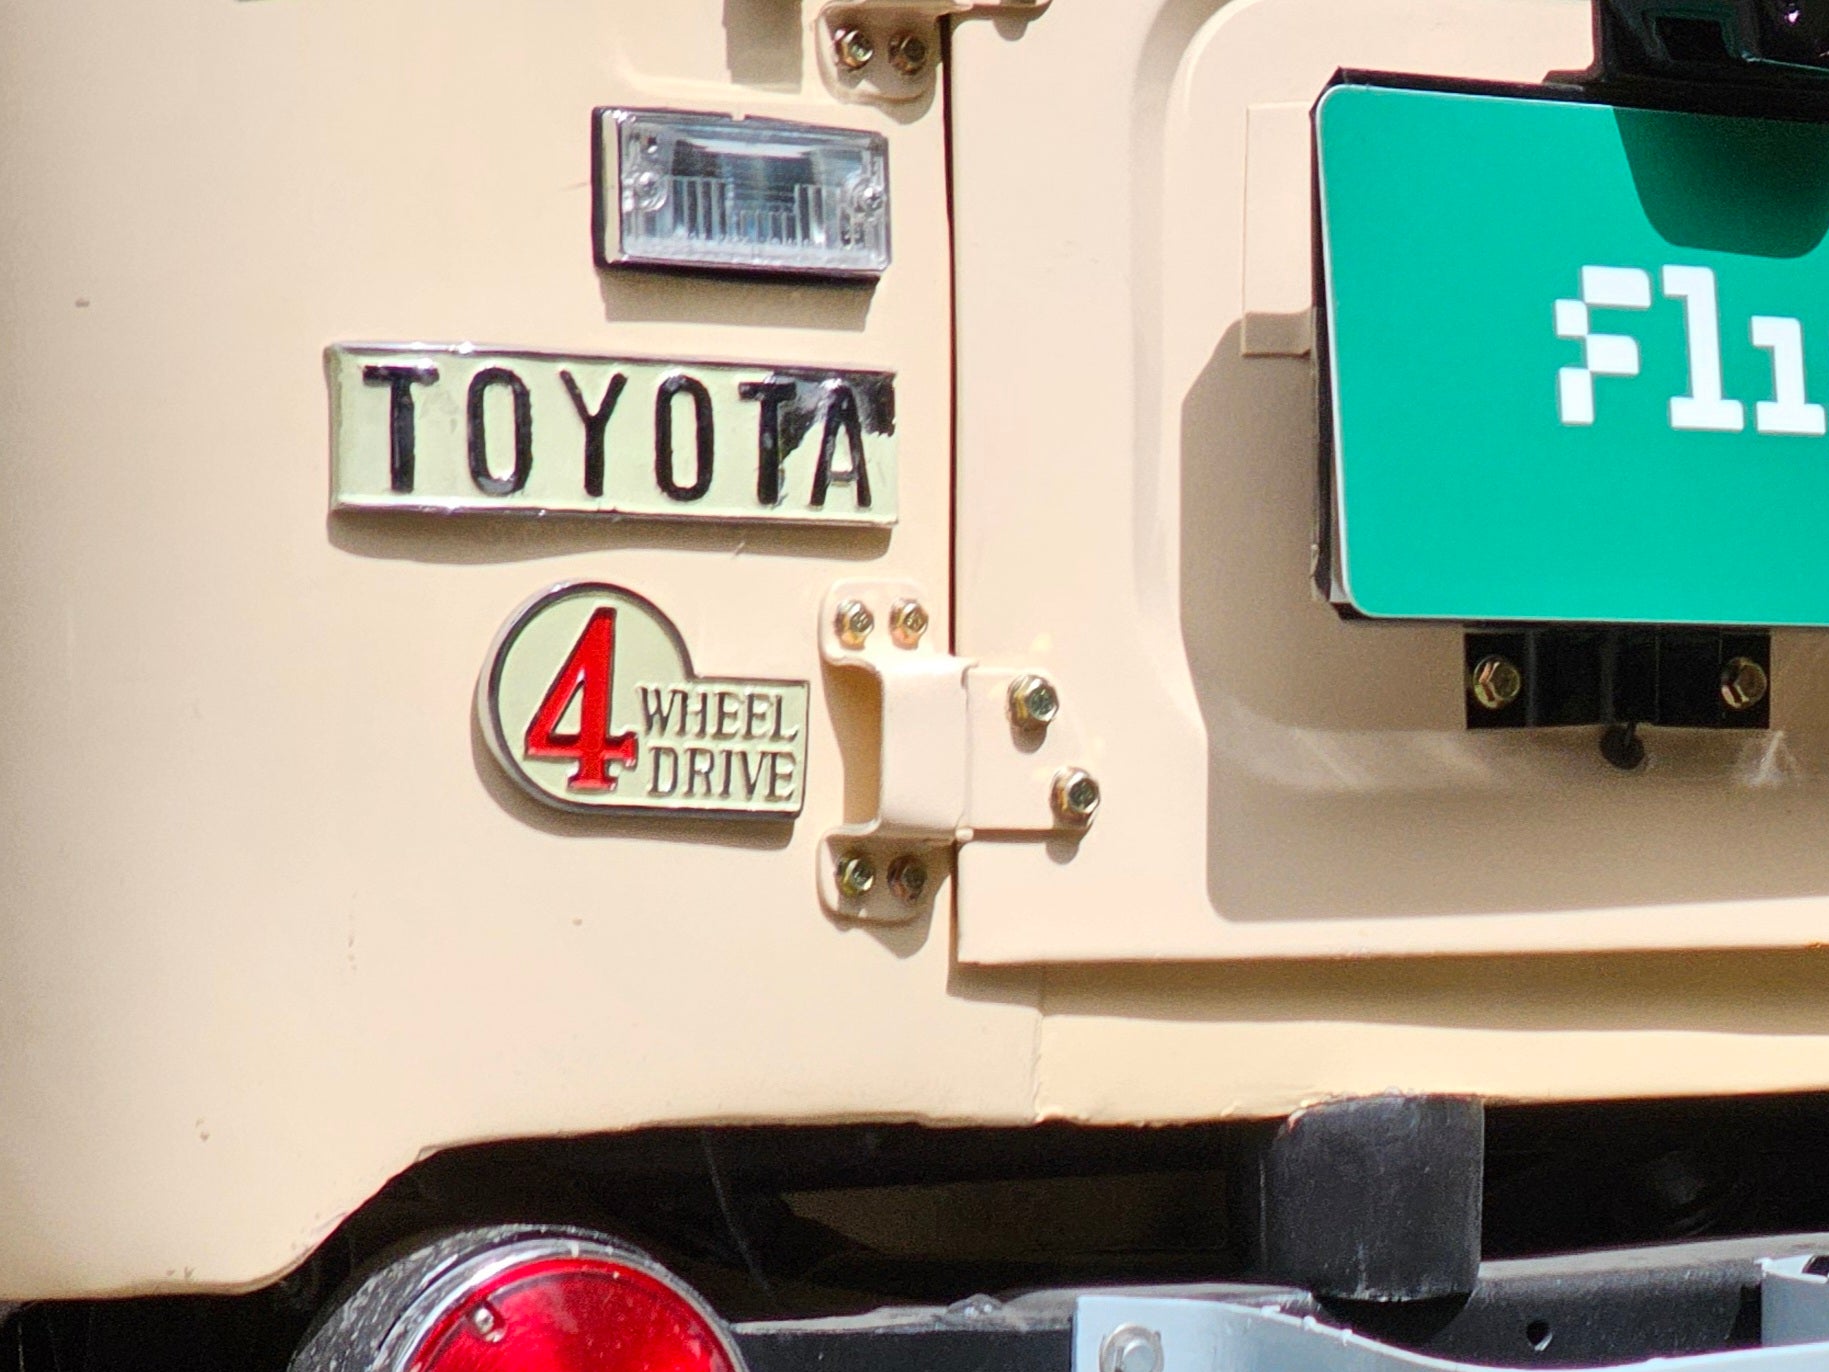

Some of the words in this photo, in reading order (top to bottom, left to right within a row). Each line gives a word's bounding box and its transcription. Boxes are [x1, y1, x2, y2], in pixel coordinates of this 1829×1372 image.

[363, 365, 872, 508] TOYOTA
[524, 606, 638, 791] 4
[637, 684, 798, 742] WHEEL
[648, 745, 796, 801] DRIVE
